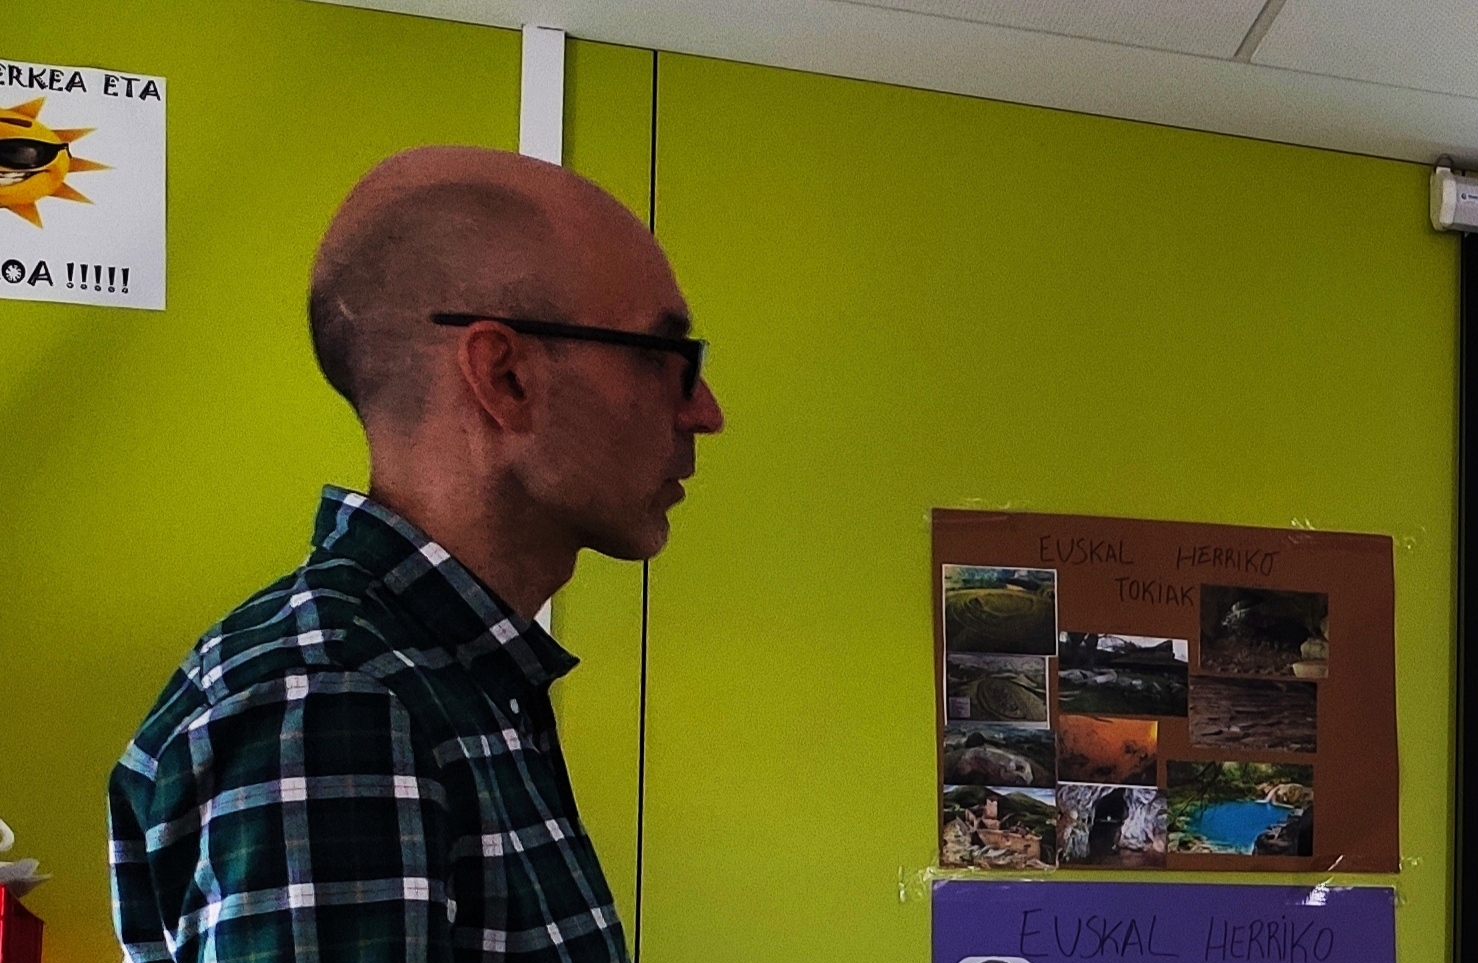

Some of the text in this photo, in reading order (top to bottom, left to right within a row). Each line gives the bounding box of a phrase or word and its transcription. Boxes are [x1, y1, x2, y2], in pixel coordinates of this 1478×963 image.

[103, 73, 161, 101] ETA
[1039, 535, 1280, 576] EUSKAL HERRIKO
[1115, 577, 1194, 606] TOKIAK
[1019, 908, 1179, 959] EUSKAL
